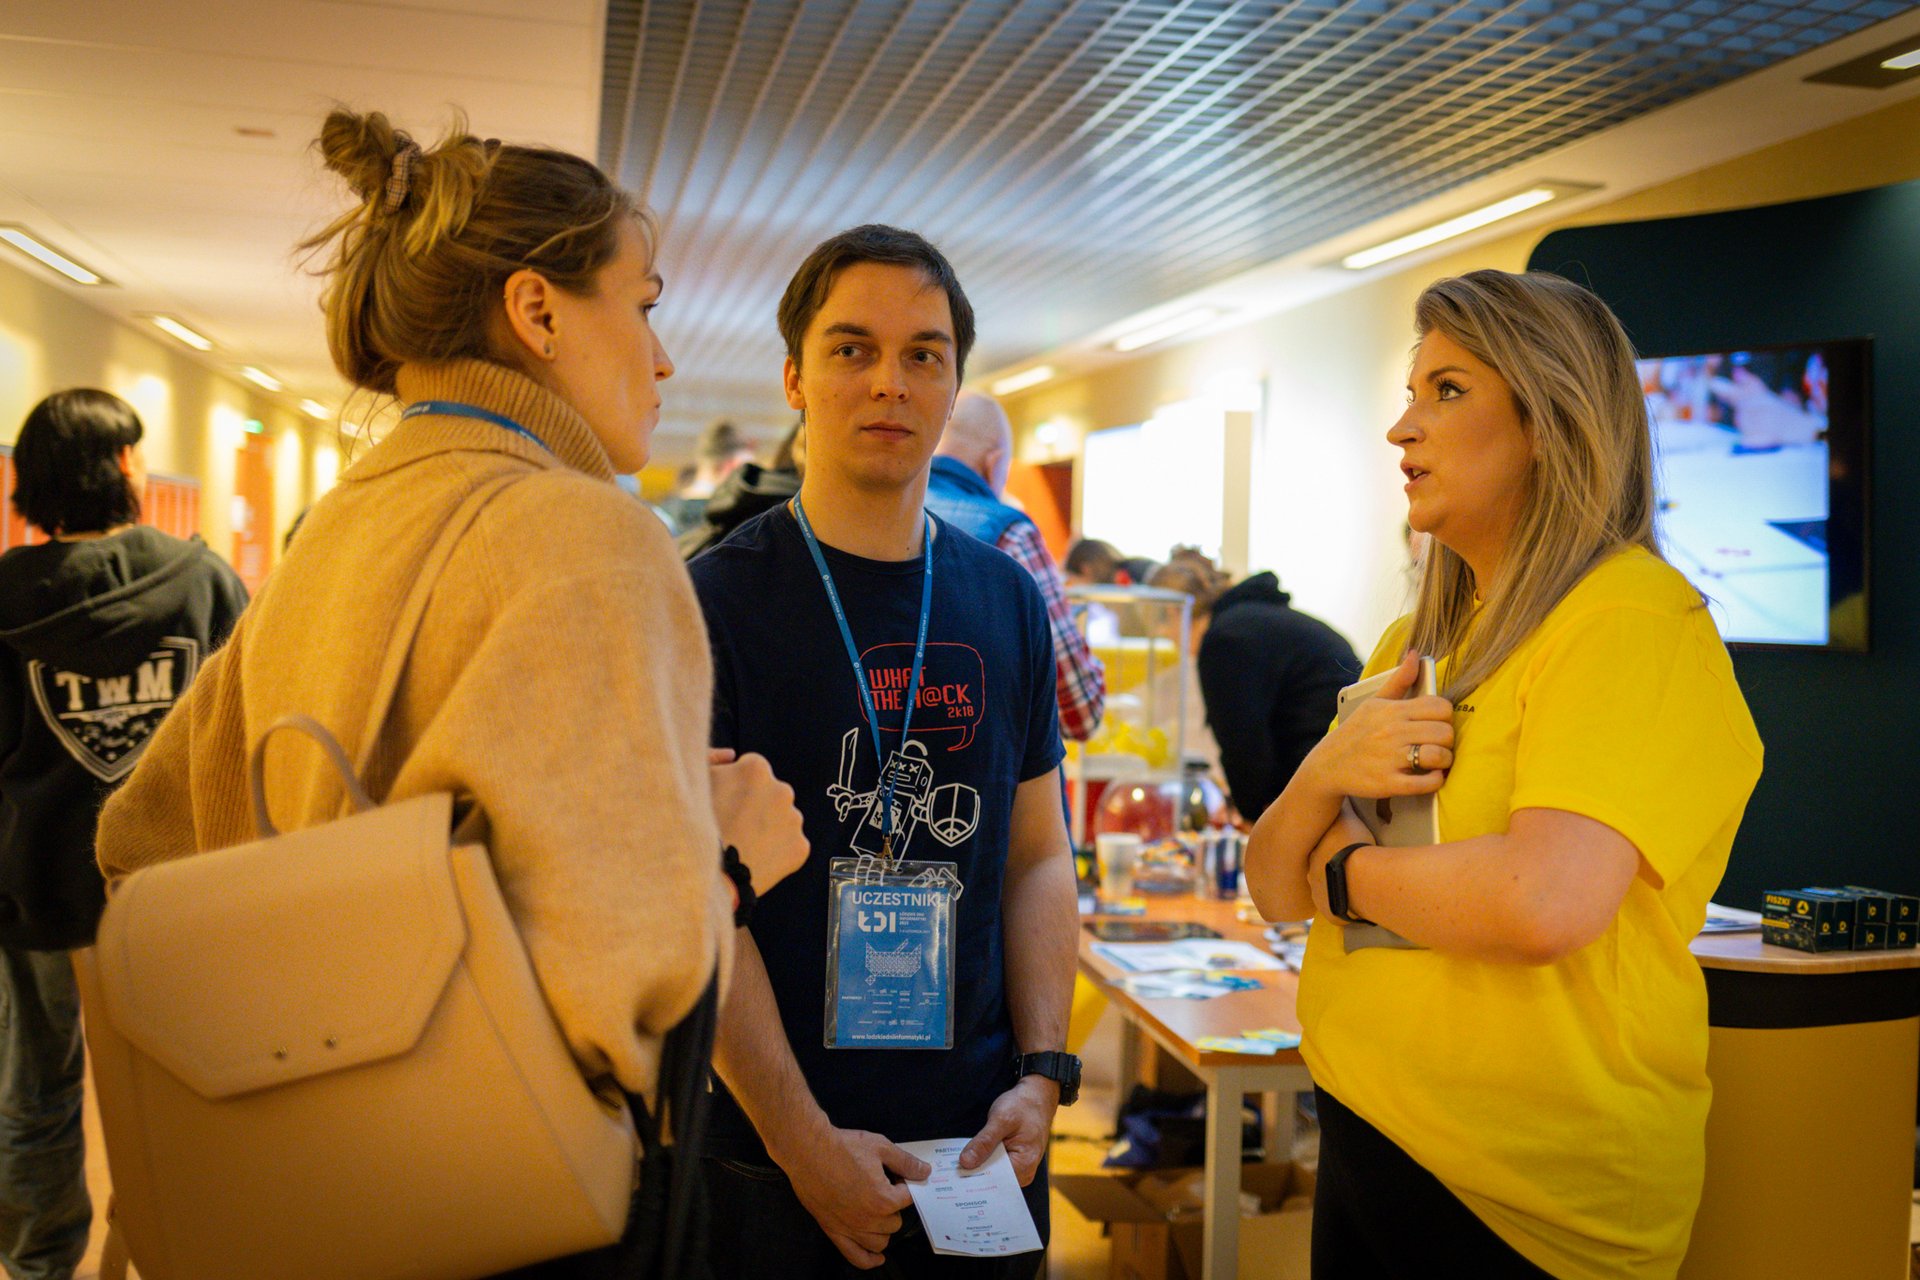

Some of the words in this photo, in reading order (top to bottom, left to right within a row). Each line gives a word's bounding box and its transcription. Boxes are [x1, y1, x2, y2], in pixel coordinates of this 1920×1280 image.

[870, 689, 904, 711] THE
[947, 705, 975, 719] 2k18
[852, 890, 938, 907] UCZESTNIK
